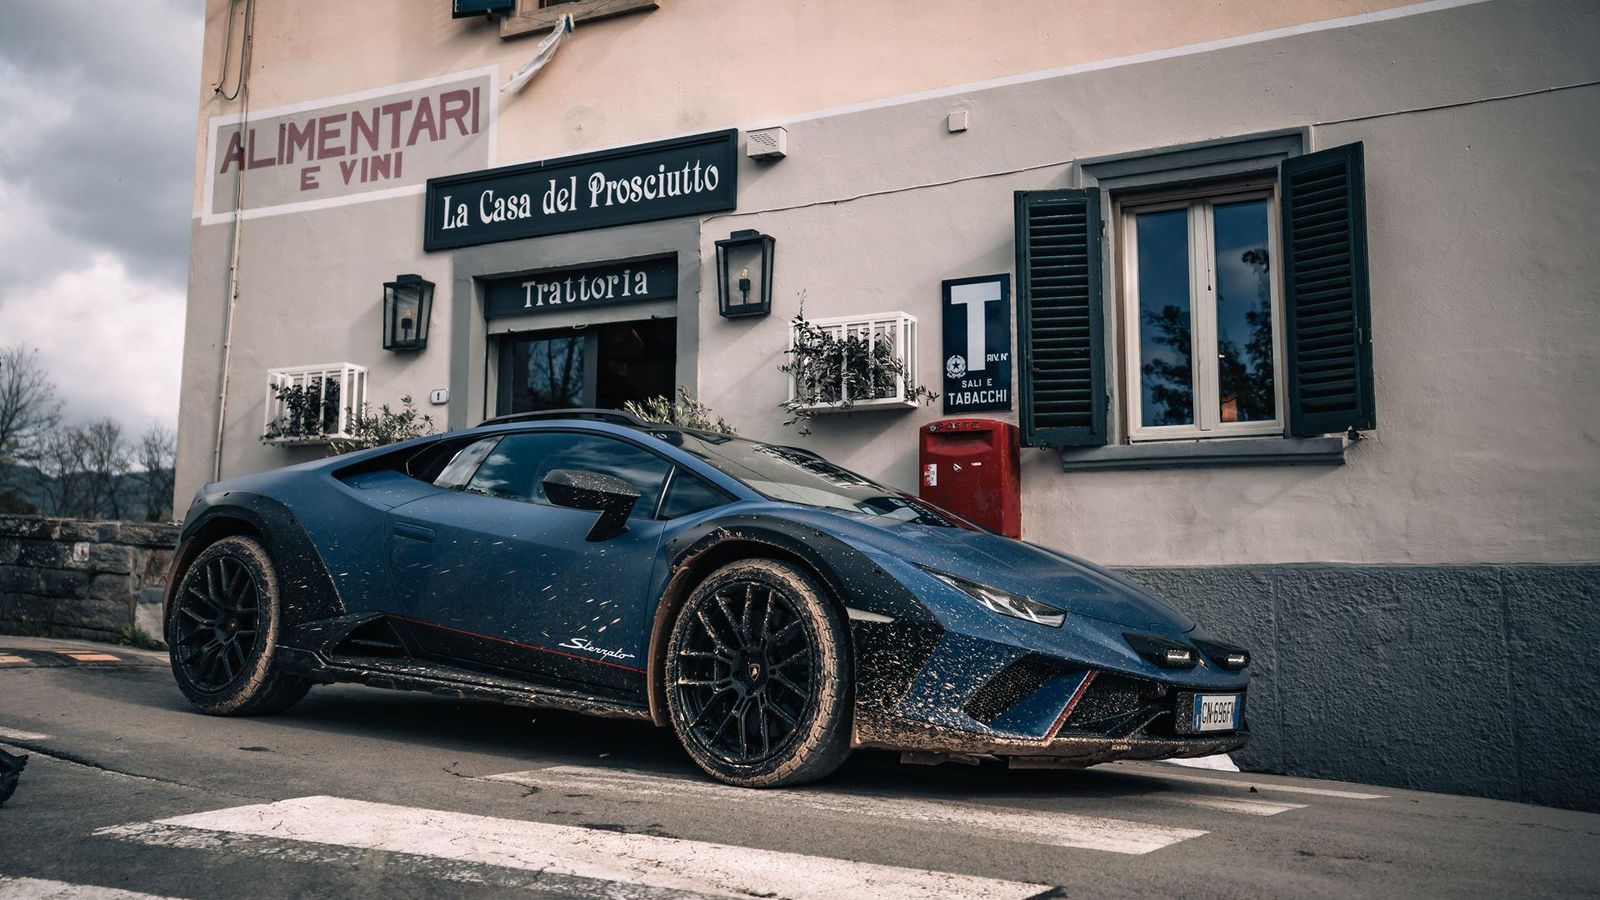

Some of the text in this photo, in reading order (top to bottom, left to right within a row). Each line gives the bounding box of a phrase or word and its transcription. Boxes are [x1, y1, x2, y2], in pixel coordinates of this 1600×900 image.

[220, 86, 480, 174] ALIMENTARI
[300, 151, 403, 191] E VINI
[441, 159, 720, 230] La Casa del Prosciutto
[521, 269, 649, 308] Trattoria
[951, 281, 1001, 371] T
[948, 389, 1007, 406] TABACCHI
[961, 378, 993, 388] SALI E
[558, 638, 636, 661] Sterrato
